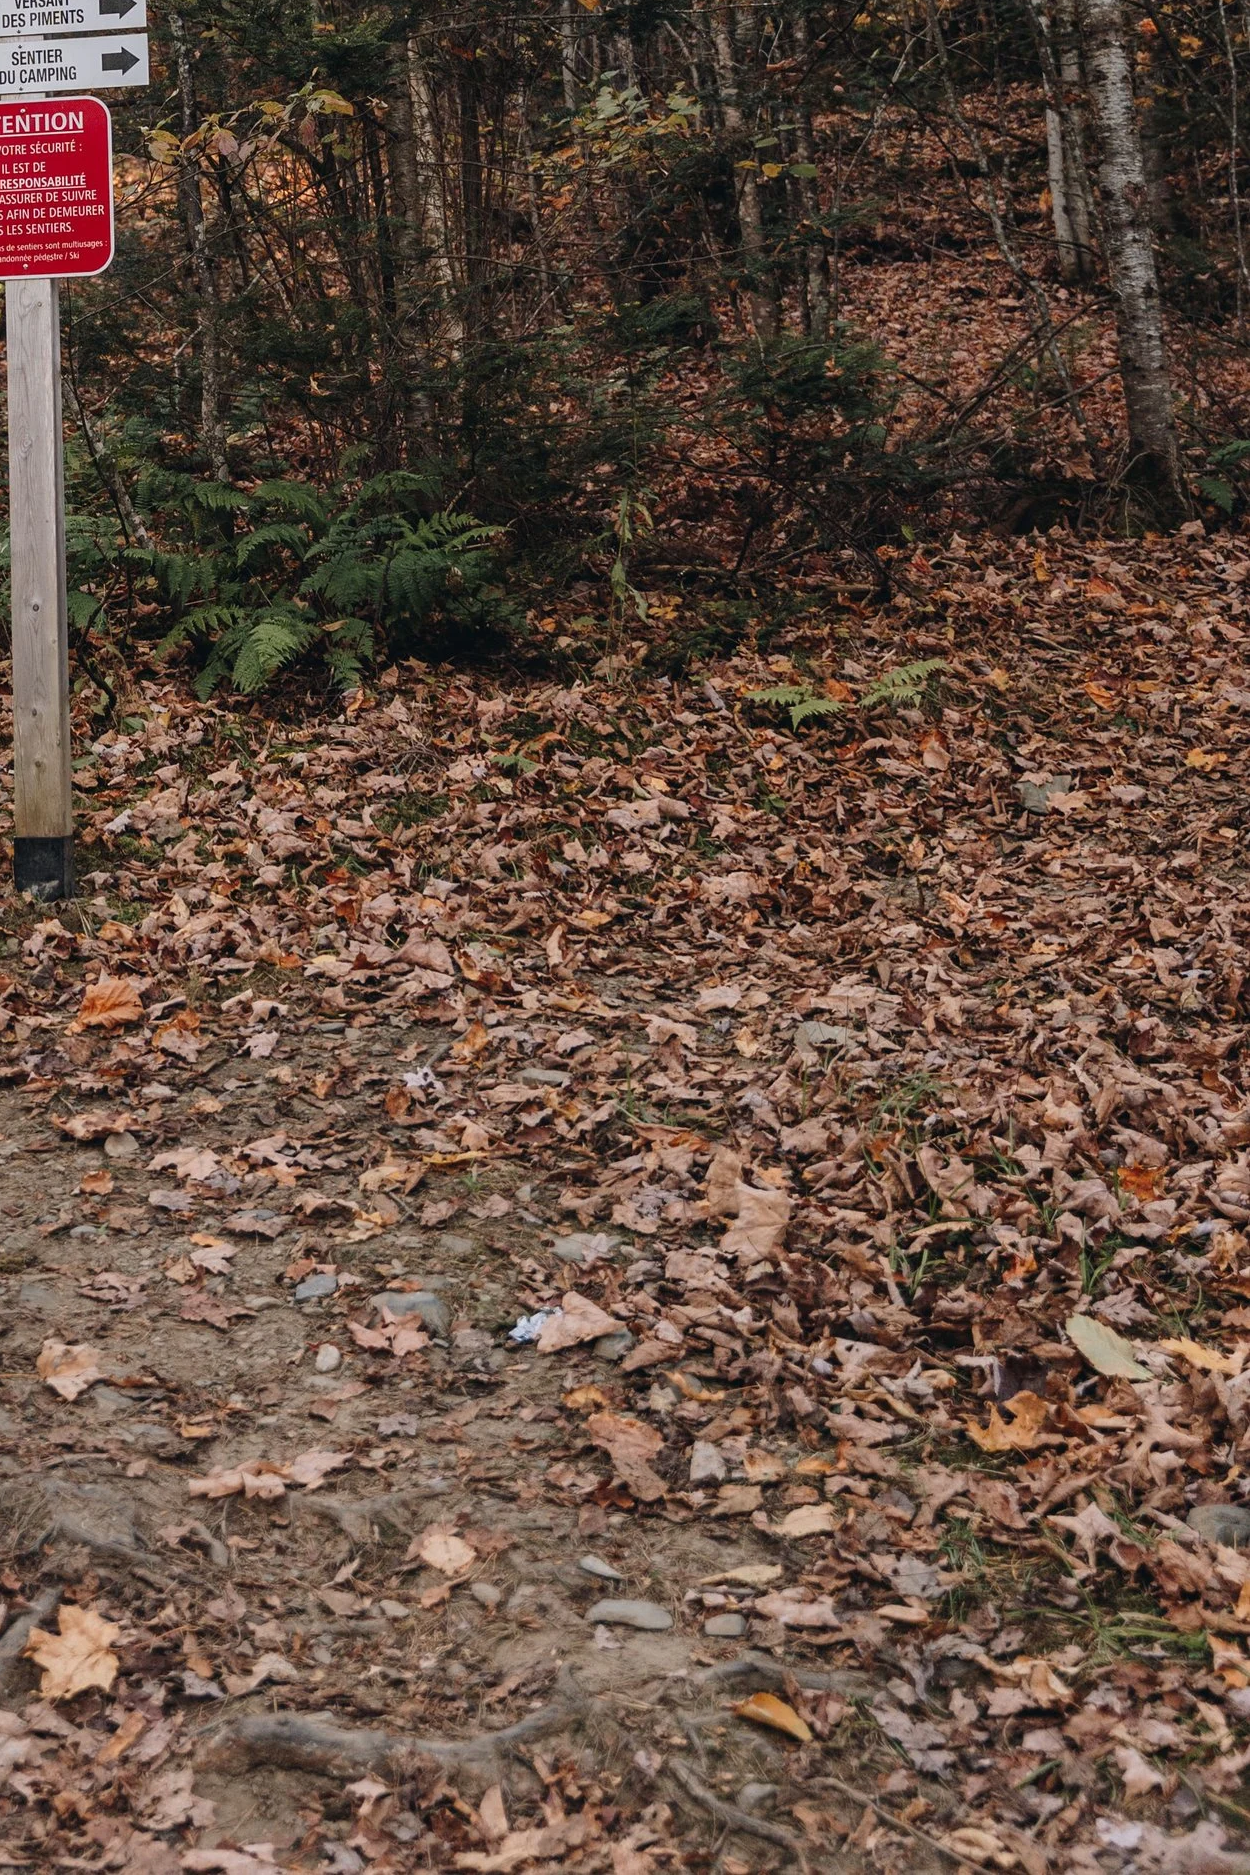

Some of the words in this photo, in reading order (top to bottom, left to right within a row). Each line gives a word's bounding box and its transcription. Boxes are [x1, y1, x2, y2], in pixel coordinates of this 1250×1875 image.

[2, 13, 25, 28] DES
[30, 9, 84, 27] PIMENTS
[12, 49, 62, 65] SENTIER
[0, 70, 15, 85] DU
[20, 66, 76, 84] CAMPING
[30, 139, 75, 154] SÉCURITÉ
[1, 164, 10, 174] IL
[13, 163, 30, 173] EST
[33, 162, 46, 172] DE
[0, 173, 86, 190] RESPONSABILITÉ
[0, 193, 43, 205] ASSURER
[46, 192, 58, 202] DE
[62, 190, 97, 201] SUIVRE
[6, 209, 29, 220] AFIN
[33, 208, 46, 218] DE
[49, 205, 104, 217] DEMEURER
[7, 225, 22, 235] LES
[26, 222, 74, 234] SENTIERS.
[17, 242, 43, 251] sentiers
[45, 241, 60, 249] sont
[62, 240, 103, 250] multiusages
[34, 252, 63, 262] pédestre
[70, 250, 79, 259] Ski
